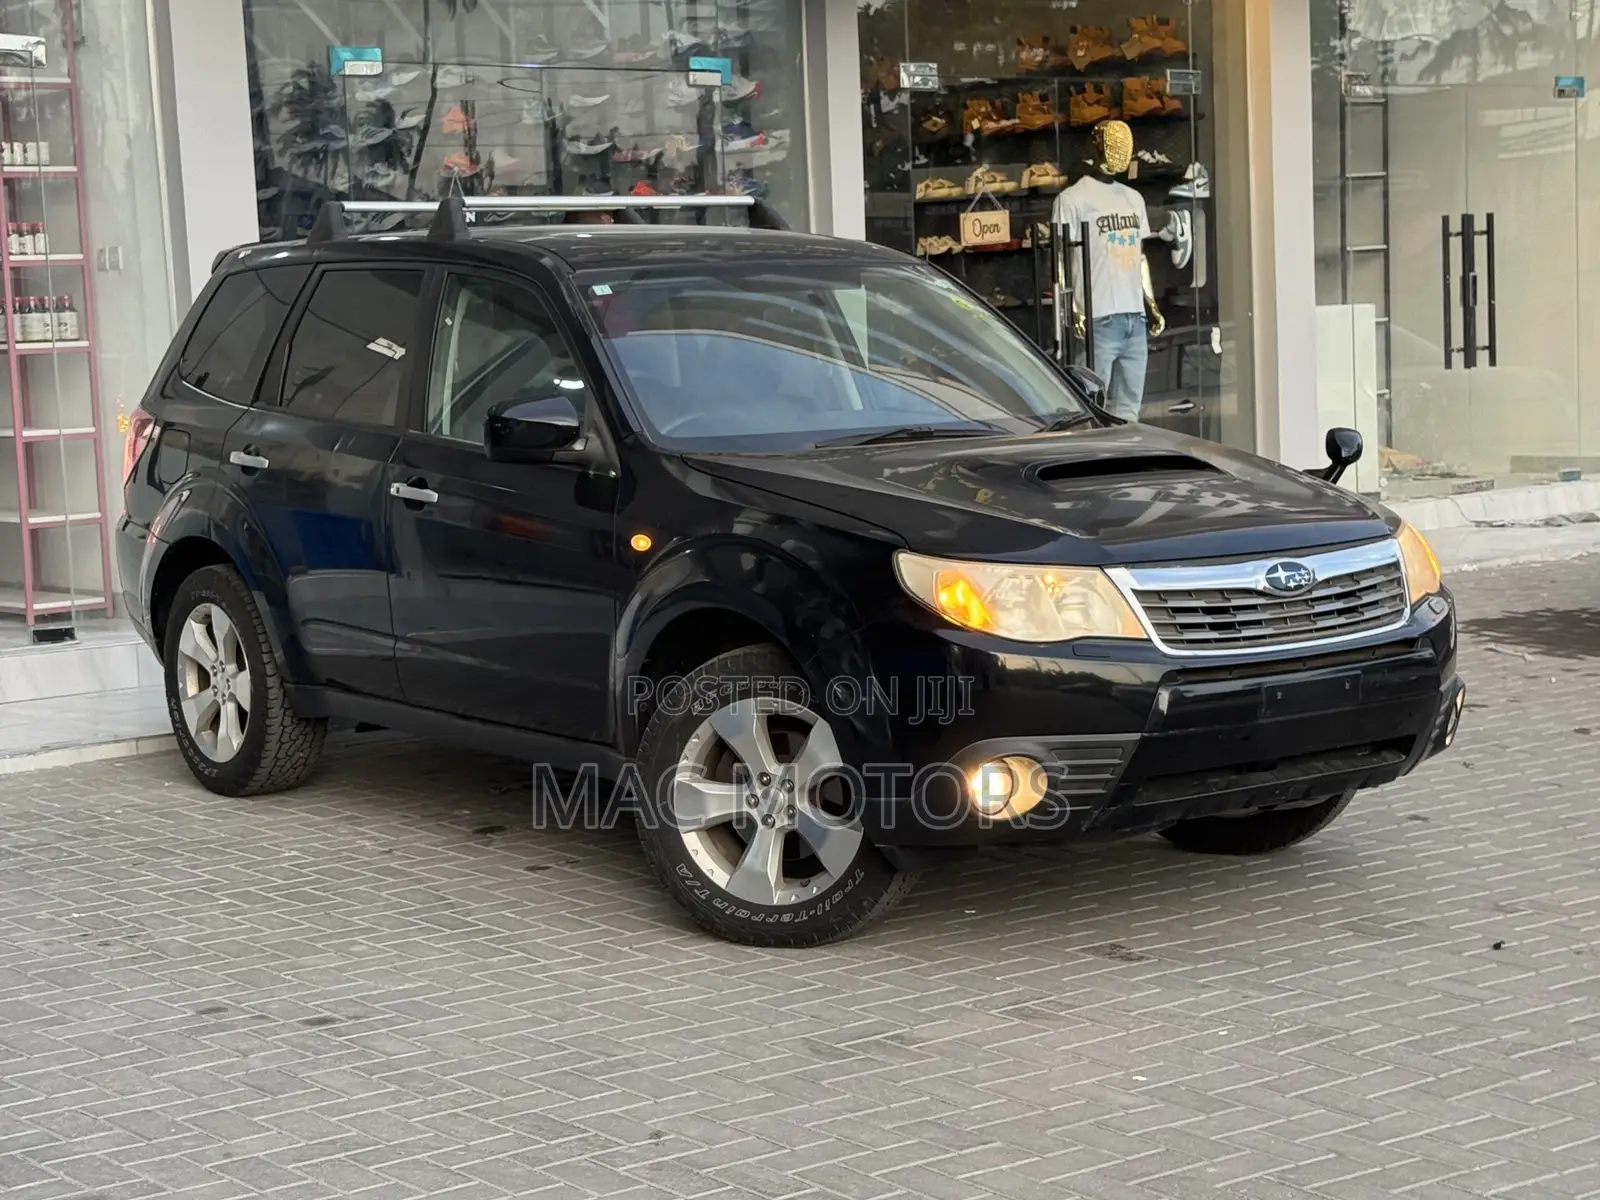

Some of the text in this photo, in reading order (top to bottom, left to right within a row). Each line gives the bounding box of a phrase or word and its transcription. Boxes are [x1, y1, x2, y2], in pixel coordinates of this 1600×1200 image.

[972, 218, 1001, 240] Open
[676, 863, 865, 923] Trail-Terrain T/A
